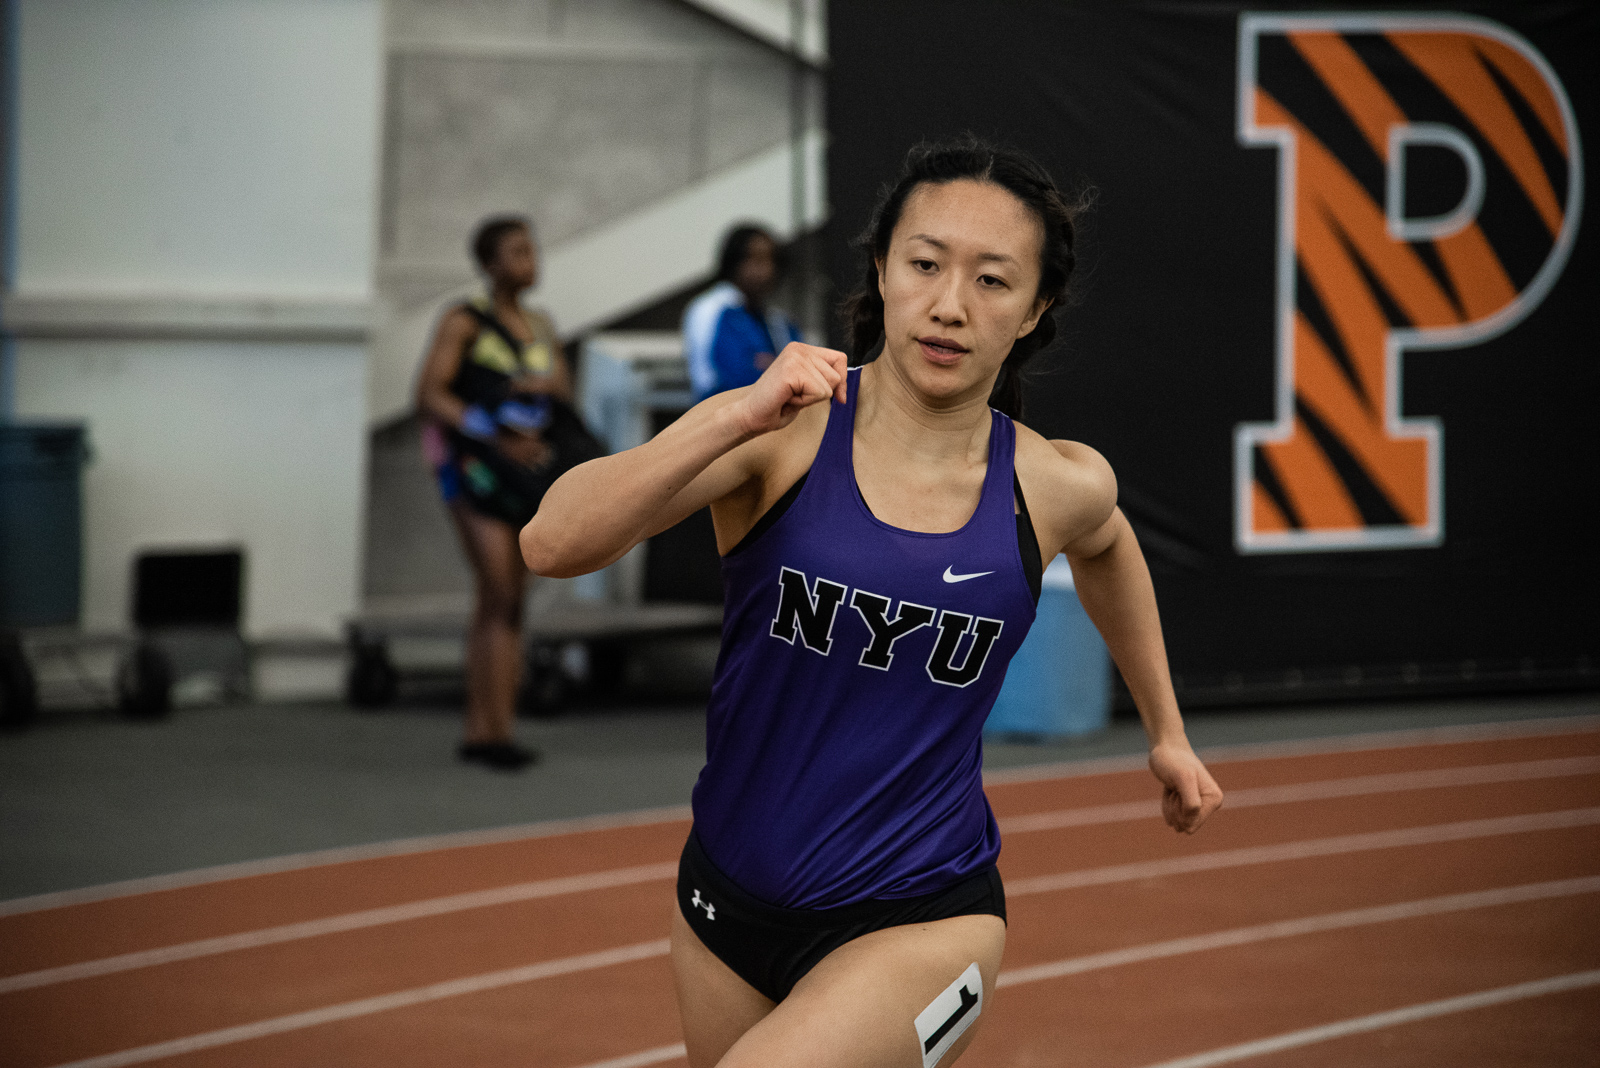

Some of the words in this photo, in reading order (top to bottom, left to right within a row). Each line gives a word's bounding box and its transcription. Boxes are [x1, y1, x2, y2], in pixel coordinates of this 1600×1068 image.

[1235, 11, 1584, 554] P
[769, 566, 1005, 688] NYU
[924, 984, 979, 1056] 1
